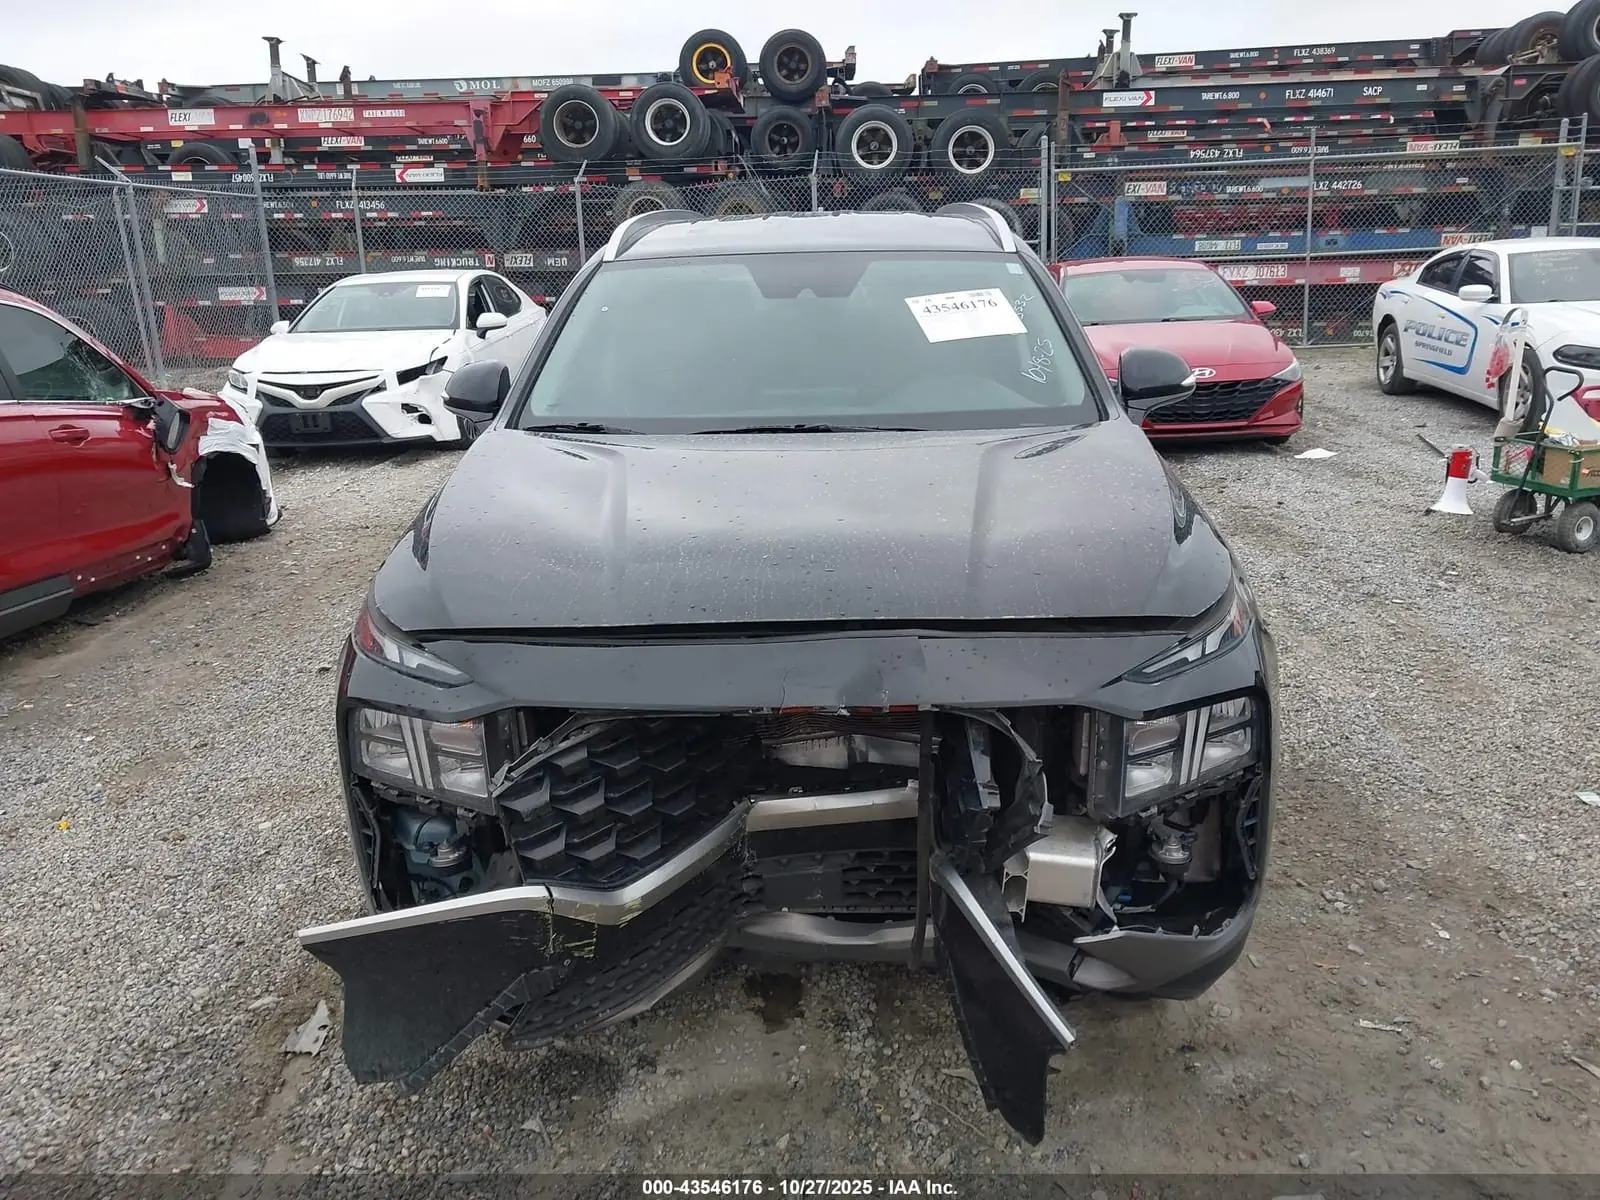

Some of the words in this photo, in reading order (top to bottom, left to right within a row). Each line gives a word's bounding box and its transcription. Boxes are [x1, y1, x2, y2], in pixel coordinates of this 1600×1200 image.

[1293, 48, 1310, 57] FLXZ
[469, 80, 500, 90] MOL
[1285, 89, 1306, 99] FLXZ
[1307, 88, 1334, 98] 414671
[1363, 86, 1383, 96] SACP
[1223, 148, 1244, 158] FLXZ
[1313, 181, 1329, 191] LXZ
[433, 256, 480, 267] TRUCKING
[923, 299, 998, 314] 43546176
[1403, 319, 1470, 348] POLICE
